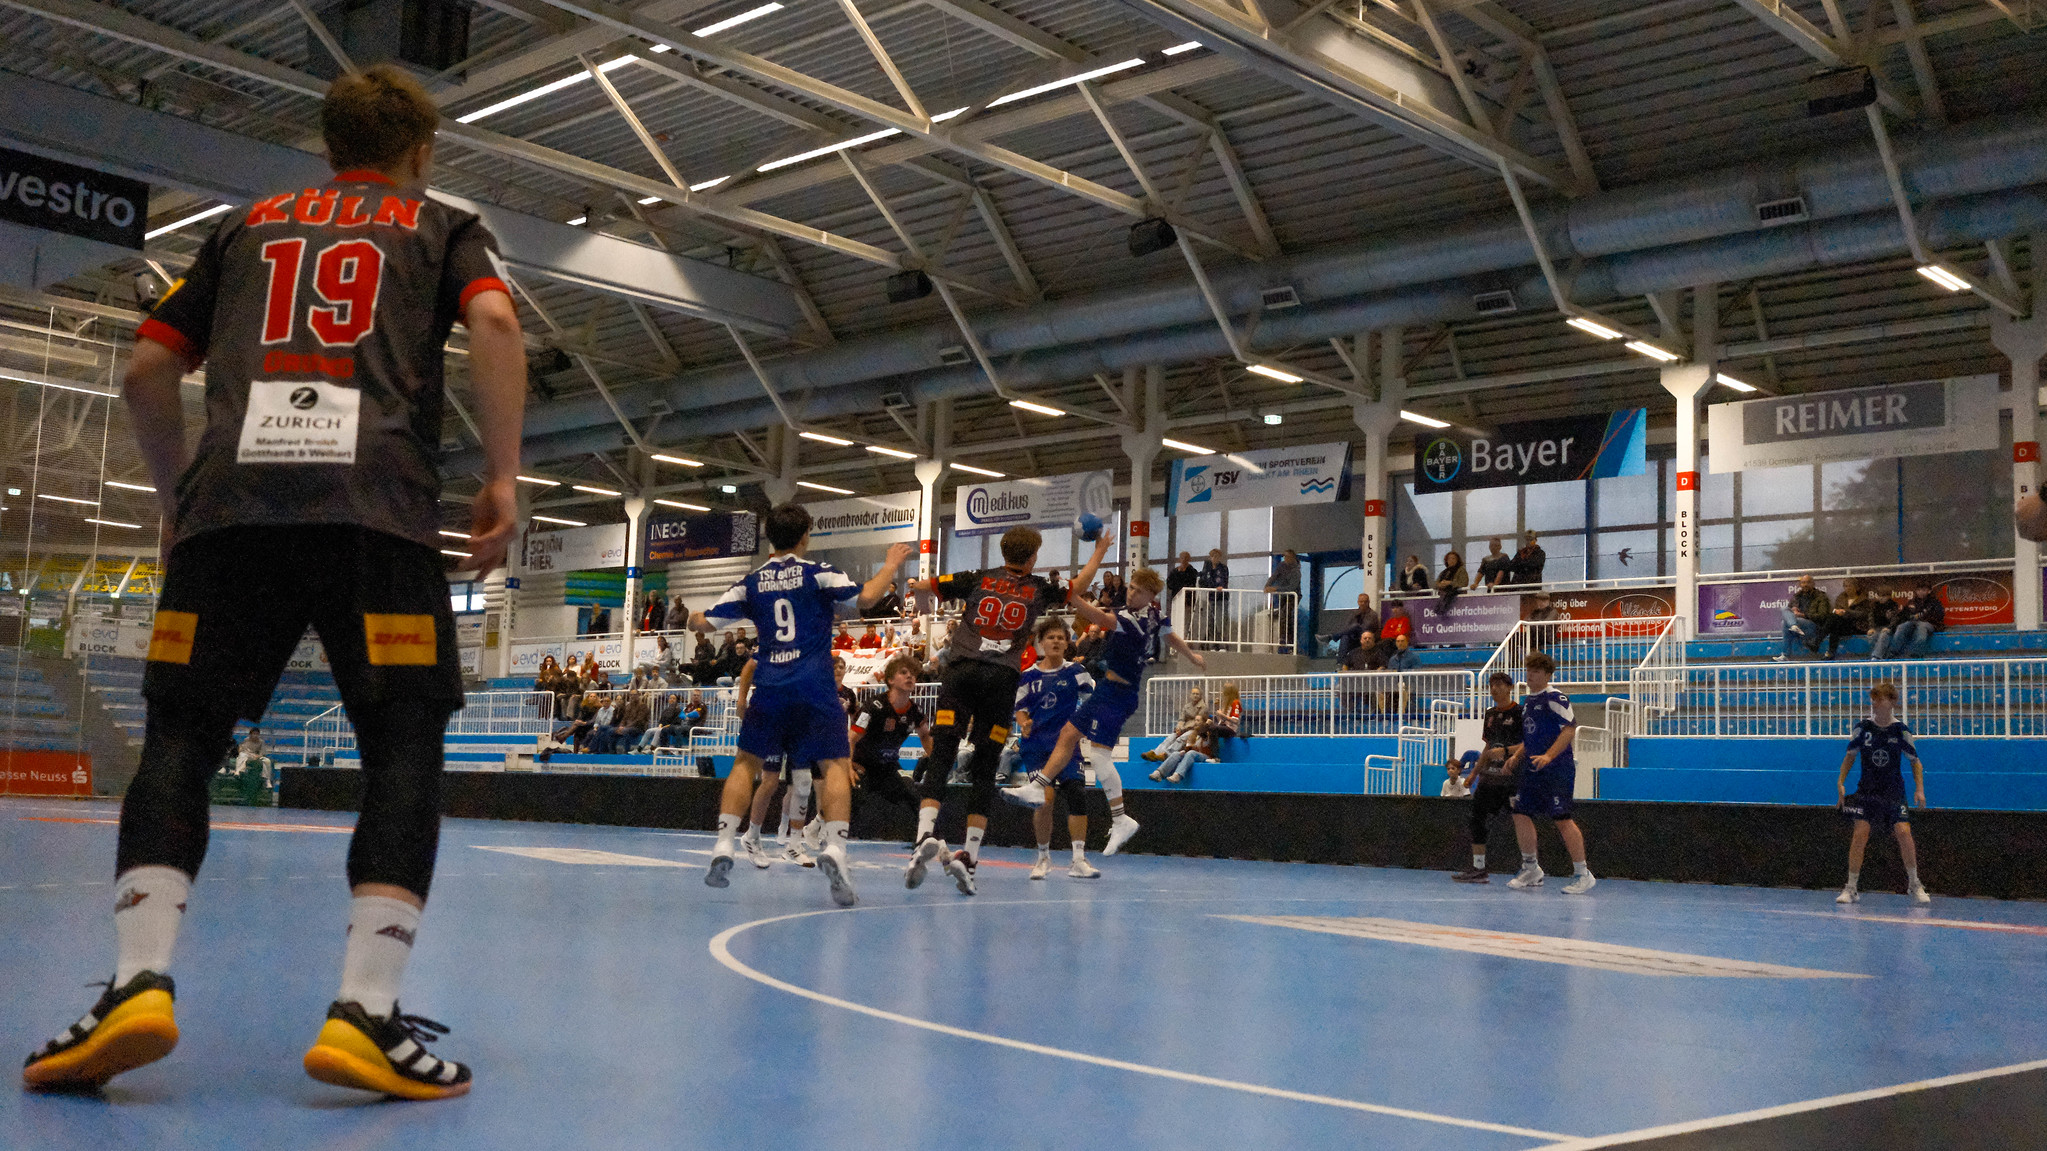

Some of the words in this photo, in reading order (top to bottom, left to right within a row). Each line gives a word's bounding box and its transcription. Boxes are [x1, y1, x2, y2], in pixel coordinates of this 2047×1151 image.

[245, 187, 425, 231] KÖLN
[261, 237, 385, 347] 19
[1776, 393, 1908, 435] REIMER
[260, 416, 341, 430] ZURICH
[1471, 437, 1574, 476] Bayer
[2019, 448, 2027, 457] D
[1269, 455, 1326, 469] SPORTVEREIN
[1427, 455, 1458, 466] BAYER
[1213, 470, 1241, 486] TSV
[1681, 478, 1688, 486] D
[882, 508, 915, 524] Zeitung
[651, 521, 687, 540] INEOS
[1133, 525, 1138, 533] C
[759, 570, 776, 581] TSV
[778, 565, 803, 580] BAYER
[981, 576, 1037, 600] KÖLN
[1570, 598, 1588, 608] über
[974, 596, 1027, 630] 99
[1447, 605, 1513, 617] alerfachbetrieb
[774, 598, 796, 642] 9
[91, 627, 119, 641] evd
[1422, 623, 1434, 633] für
[79, 642, 117, 653] BLOCK
[606, 642, 622, 655] evd
[641, 648, 655, 659] evd
[286, 660, 313, 669] OCK
[520, 652, 539, 666] evd
[598, 659, 620, 669] BLOCK
[1031, 680, 1042, 693] 17
[1864, 732, 1872, 746] 2
[30, 770, 67, 782] Neuss
[1901, 805, 1907, 814] 2
